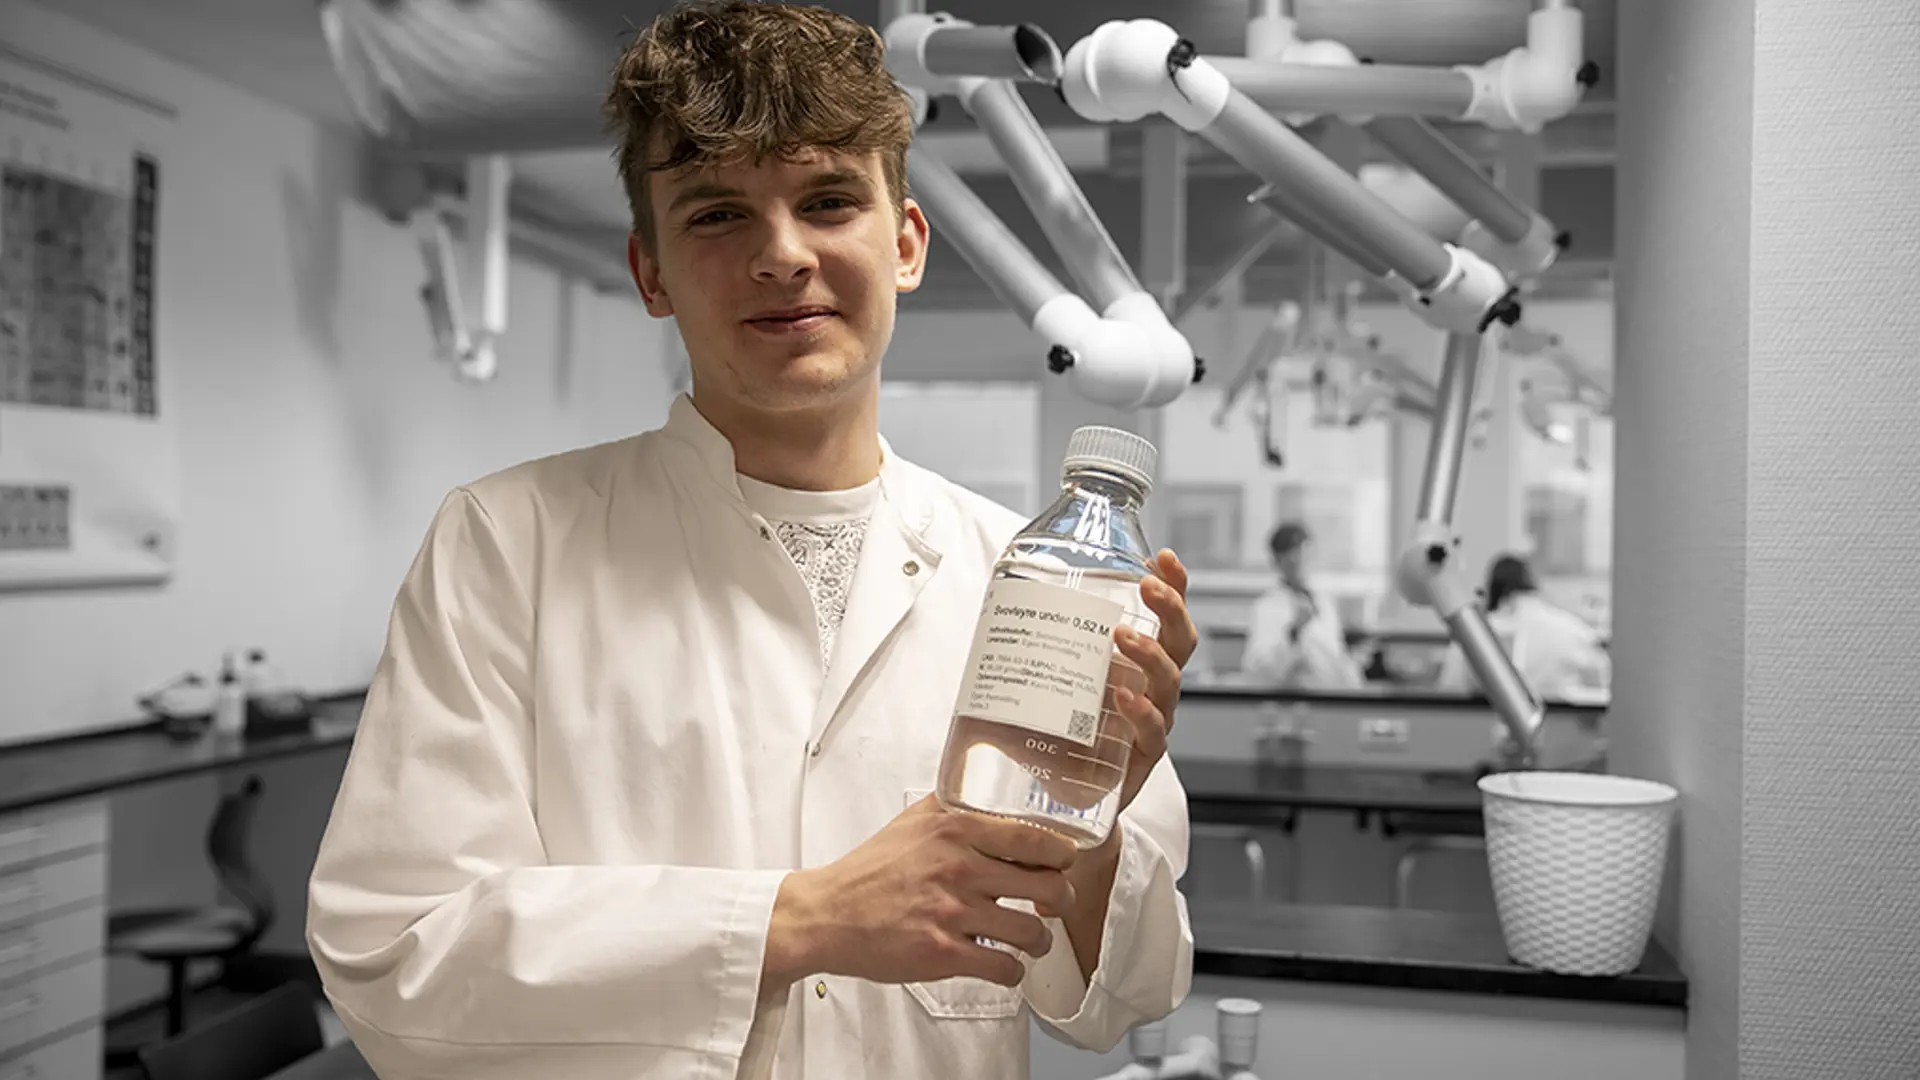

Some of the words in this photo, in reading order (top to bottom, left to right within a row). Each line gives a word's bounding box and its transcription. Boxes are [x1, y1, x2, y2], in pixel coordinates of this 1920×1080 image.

[1039, 611, 1070, 623] under
[1073, 617, 1098, 633] 0,52
[1099, 624, 1110, 637] M
